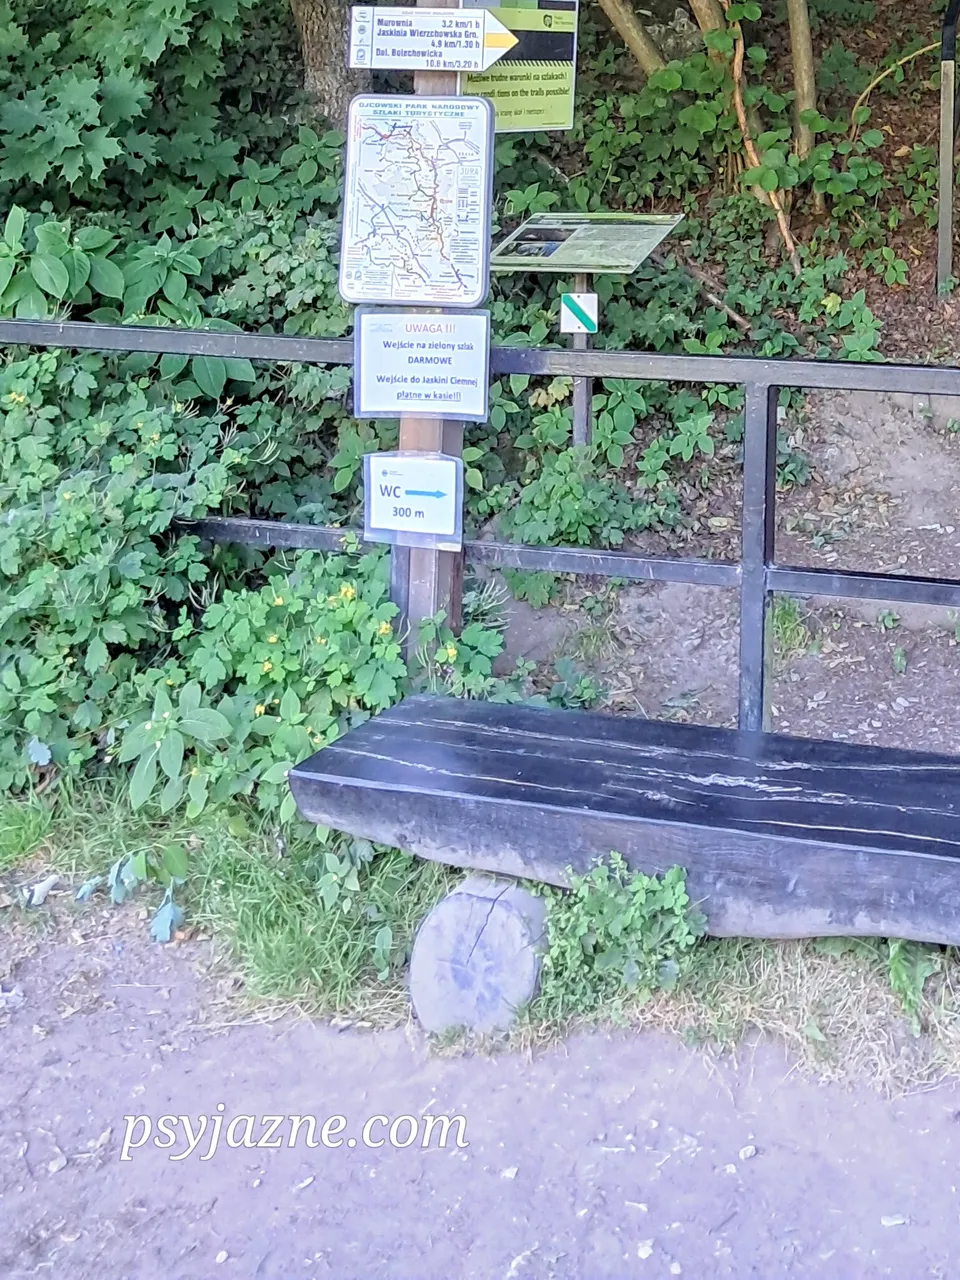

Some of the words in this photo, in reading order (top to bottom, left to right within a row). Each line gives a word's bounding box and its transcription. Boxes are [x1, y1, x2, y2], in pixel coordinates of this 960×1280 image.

[377, 19, 413, 27] Murownia
[475, 20, 480, 28] h
[377, 28, 407, 37] Jaskinia
[410, 29, 462, 38] Wierzchowska
[392, 49, 442, 57] Bolechowicka
[474, 60, 478, 68] h
[520, 89, 529, 97] the
[460, 167, 479, 175] JURA
[406, 324, 442, 333] UWAGA
[383, 341, 414, 349] Wejście
[428, 341, 455, 351] zielony
[458, 342, 474, 350] szlak
[408, 356, 452, 365] DARMOWE
[377, 375, 408, 384] Wejście
[422, 376, 448, 384] Jaskini
[450, 377, 478, 387] Ciemnej
[397, 391, 422, 400] płatne
[380, 484, 401, 498] WC
[393, 507, 411, 517] 300
[415, 510, 424, 518] m
